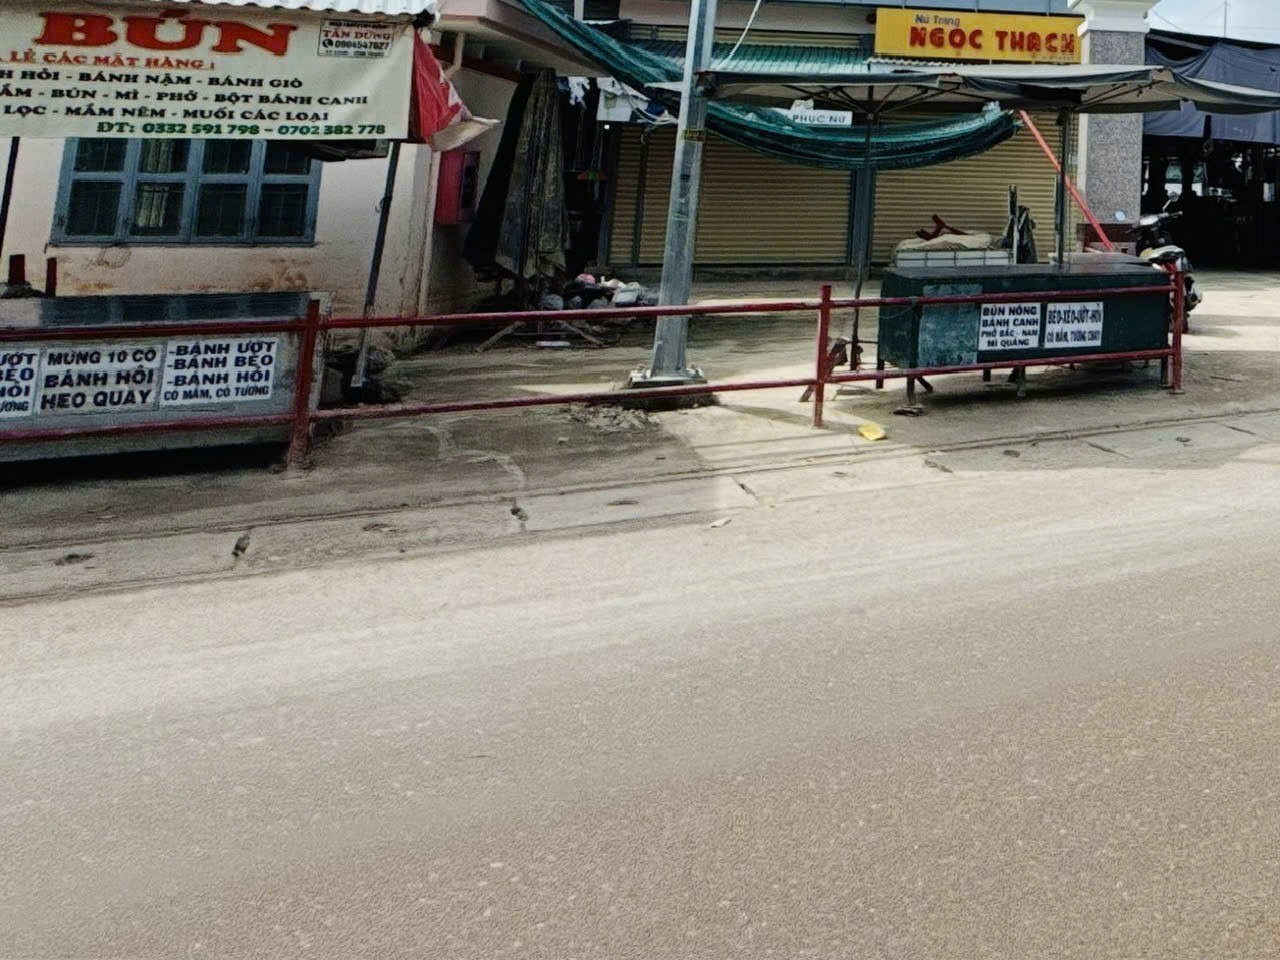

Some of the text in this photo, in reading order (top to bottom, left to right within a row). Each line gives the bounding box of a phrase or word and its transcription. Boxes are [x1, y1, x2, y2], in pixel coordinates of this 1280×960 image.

[34, 9, 298, 56] BÚN
[43, 50, 88, 64] CÁC
[20, 68, 60, 81] HỎI
[79, 70, 139, 83] BÁNH
[145, 73, 192, 87] NẬM
[207, 75, 264, 87] BÁNH
[269, 77, 303, 88] GIÒ
[51, 87, 97, 99] BÚN
[156, 90, 199, 102] PHỞ
[214, 92, 254, 105] BỘT
[258, 93, 313, 105] BÁNH
[317, 96, 368, 105] CANH
[4, 103, 329, 122] LỌC MẮM NÊM MUỐI CÁC LOẠI
[141, 123, 187, 134] 0332
[191, 124, 222, 134] 591
[227, 124, 260, 134] 798
[278, 125, 321, 135] 0702
[323, 125, 354, 135] 382
[357, 125, 386, 135] 778
[1012, 318, 1039, 327] CANH
[44, 368, 108, 388] BÁNH
[40, 388, 151, 410] HEO QUAY
